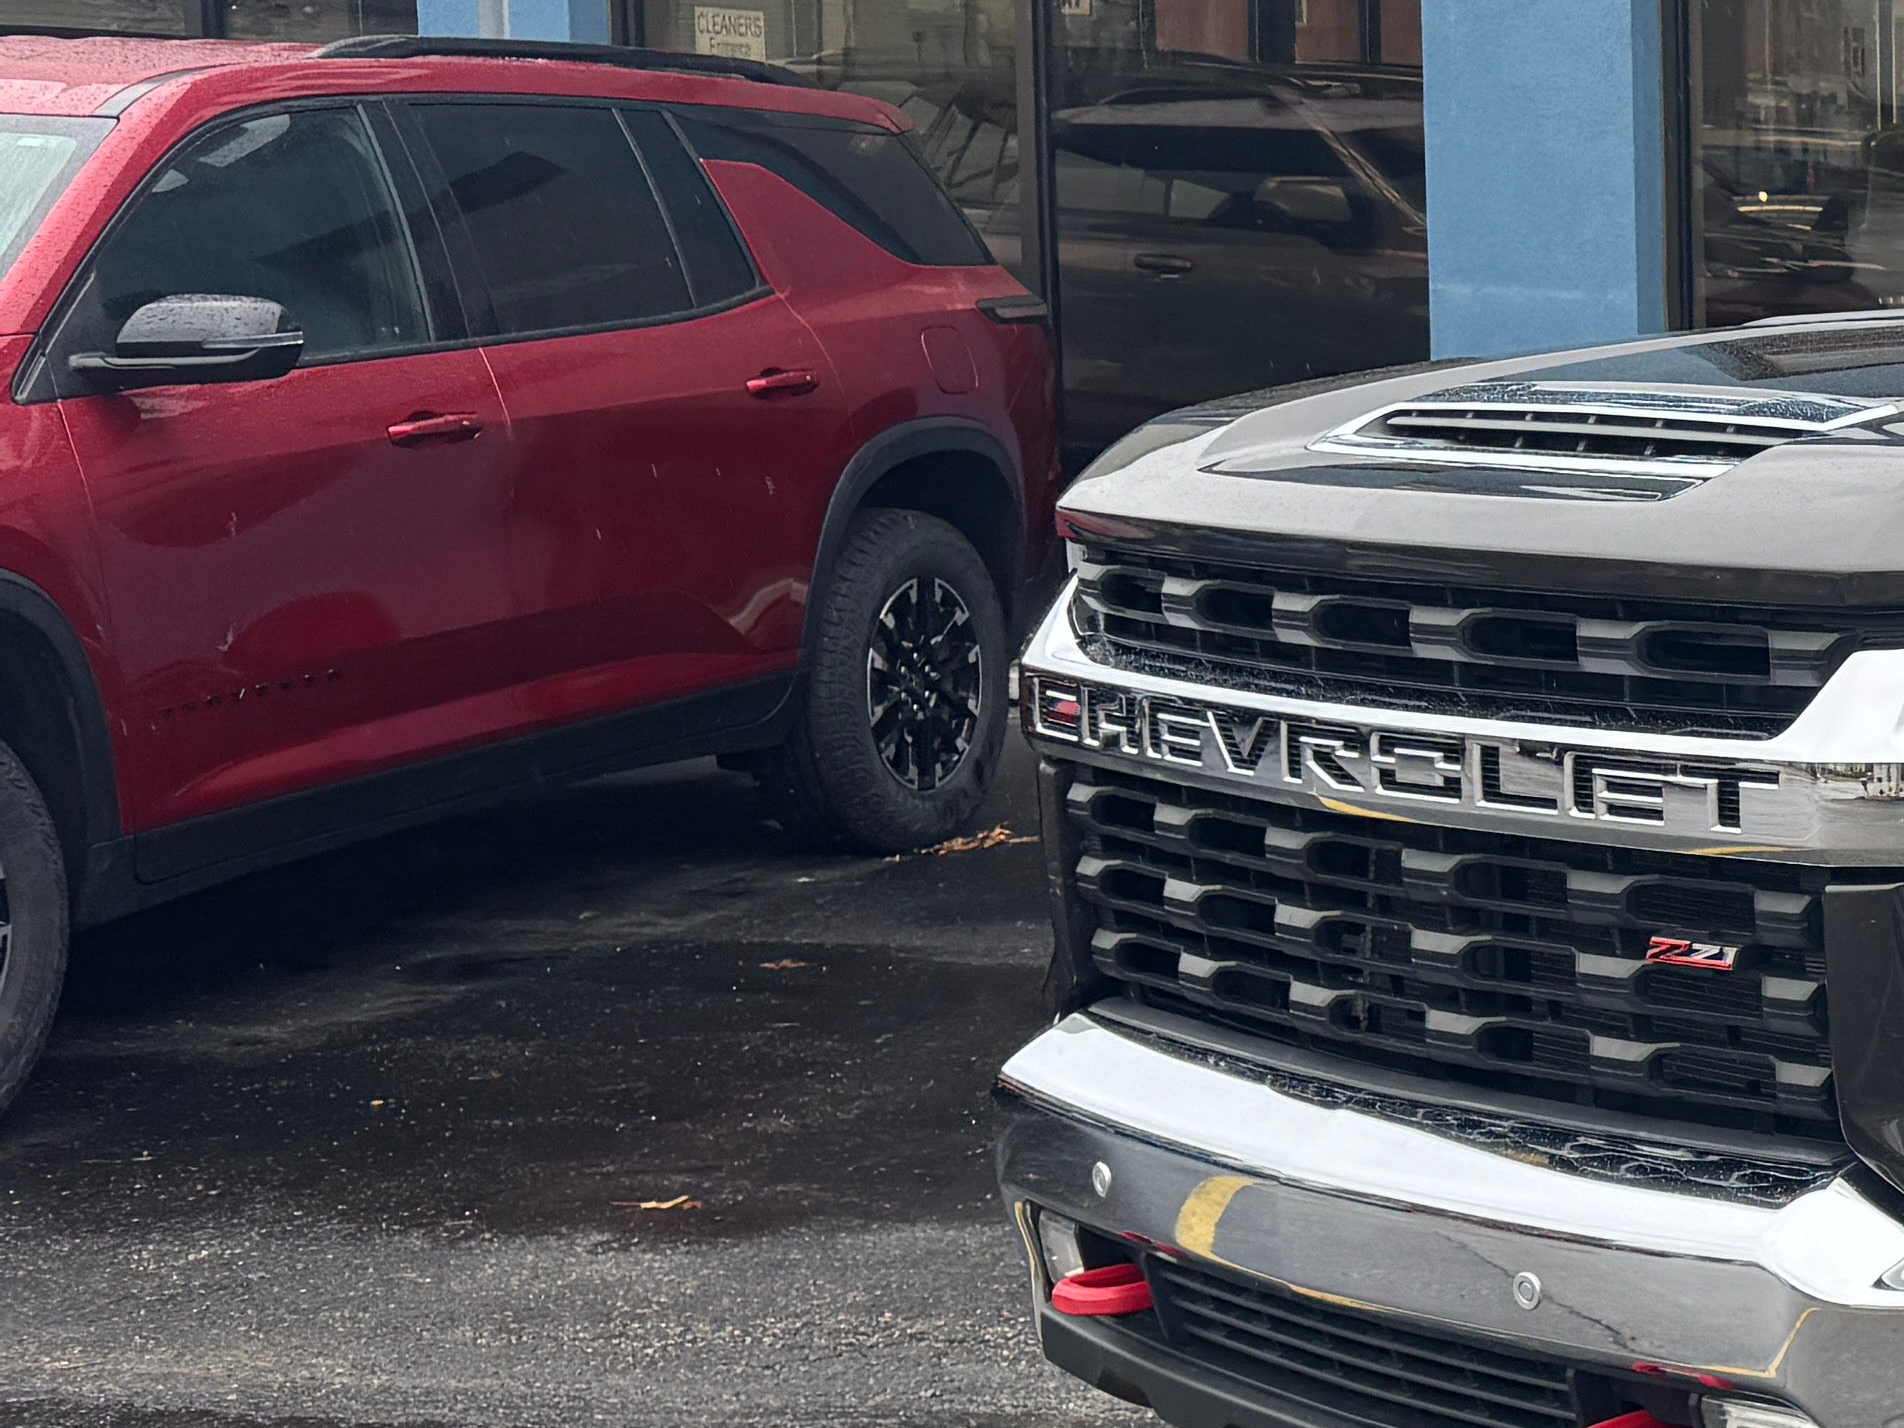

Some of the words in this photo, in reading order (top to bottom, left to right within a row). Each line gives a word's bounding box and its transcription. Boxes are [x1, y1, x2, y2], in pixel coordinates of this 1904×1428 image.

[698, 12, 762, 38] CLEANERS
[1033, 685, 1781, 834] CHEVROLET
[1646, 936, 1739, 970] Z71
